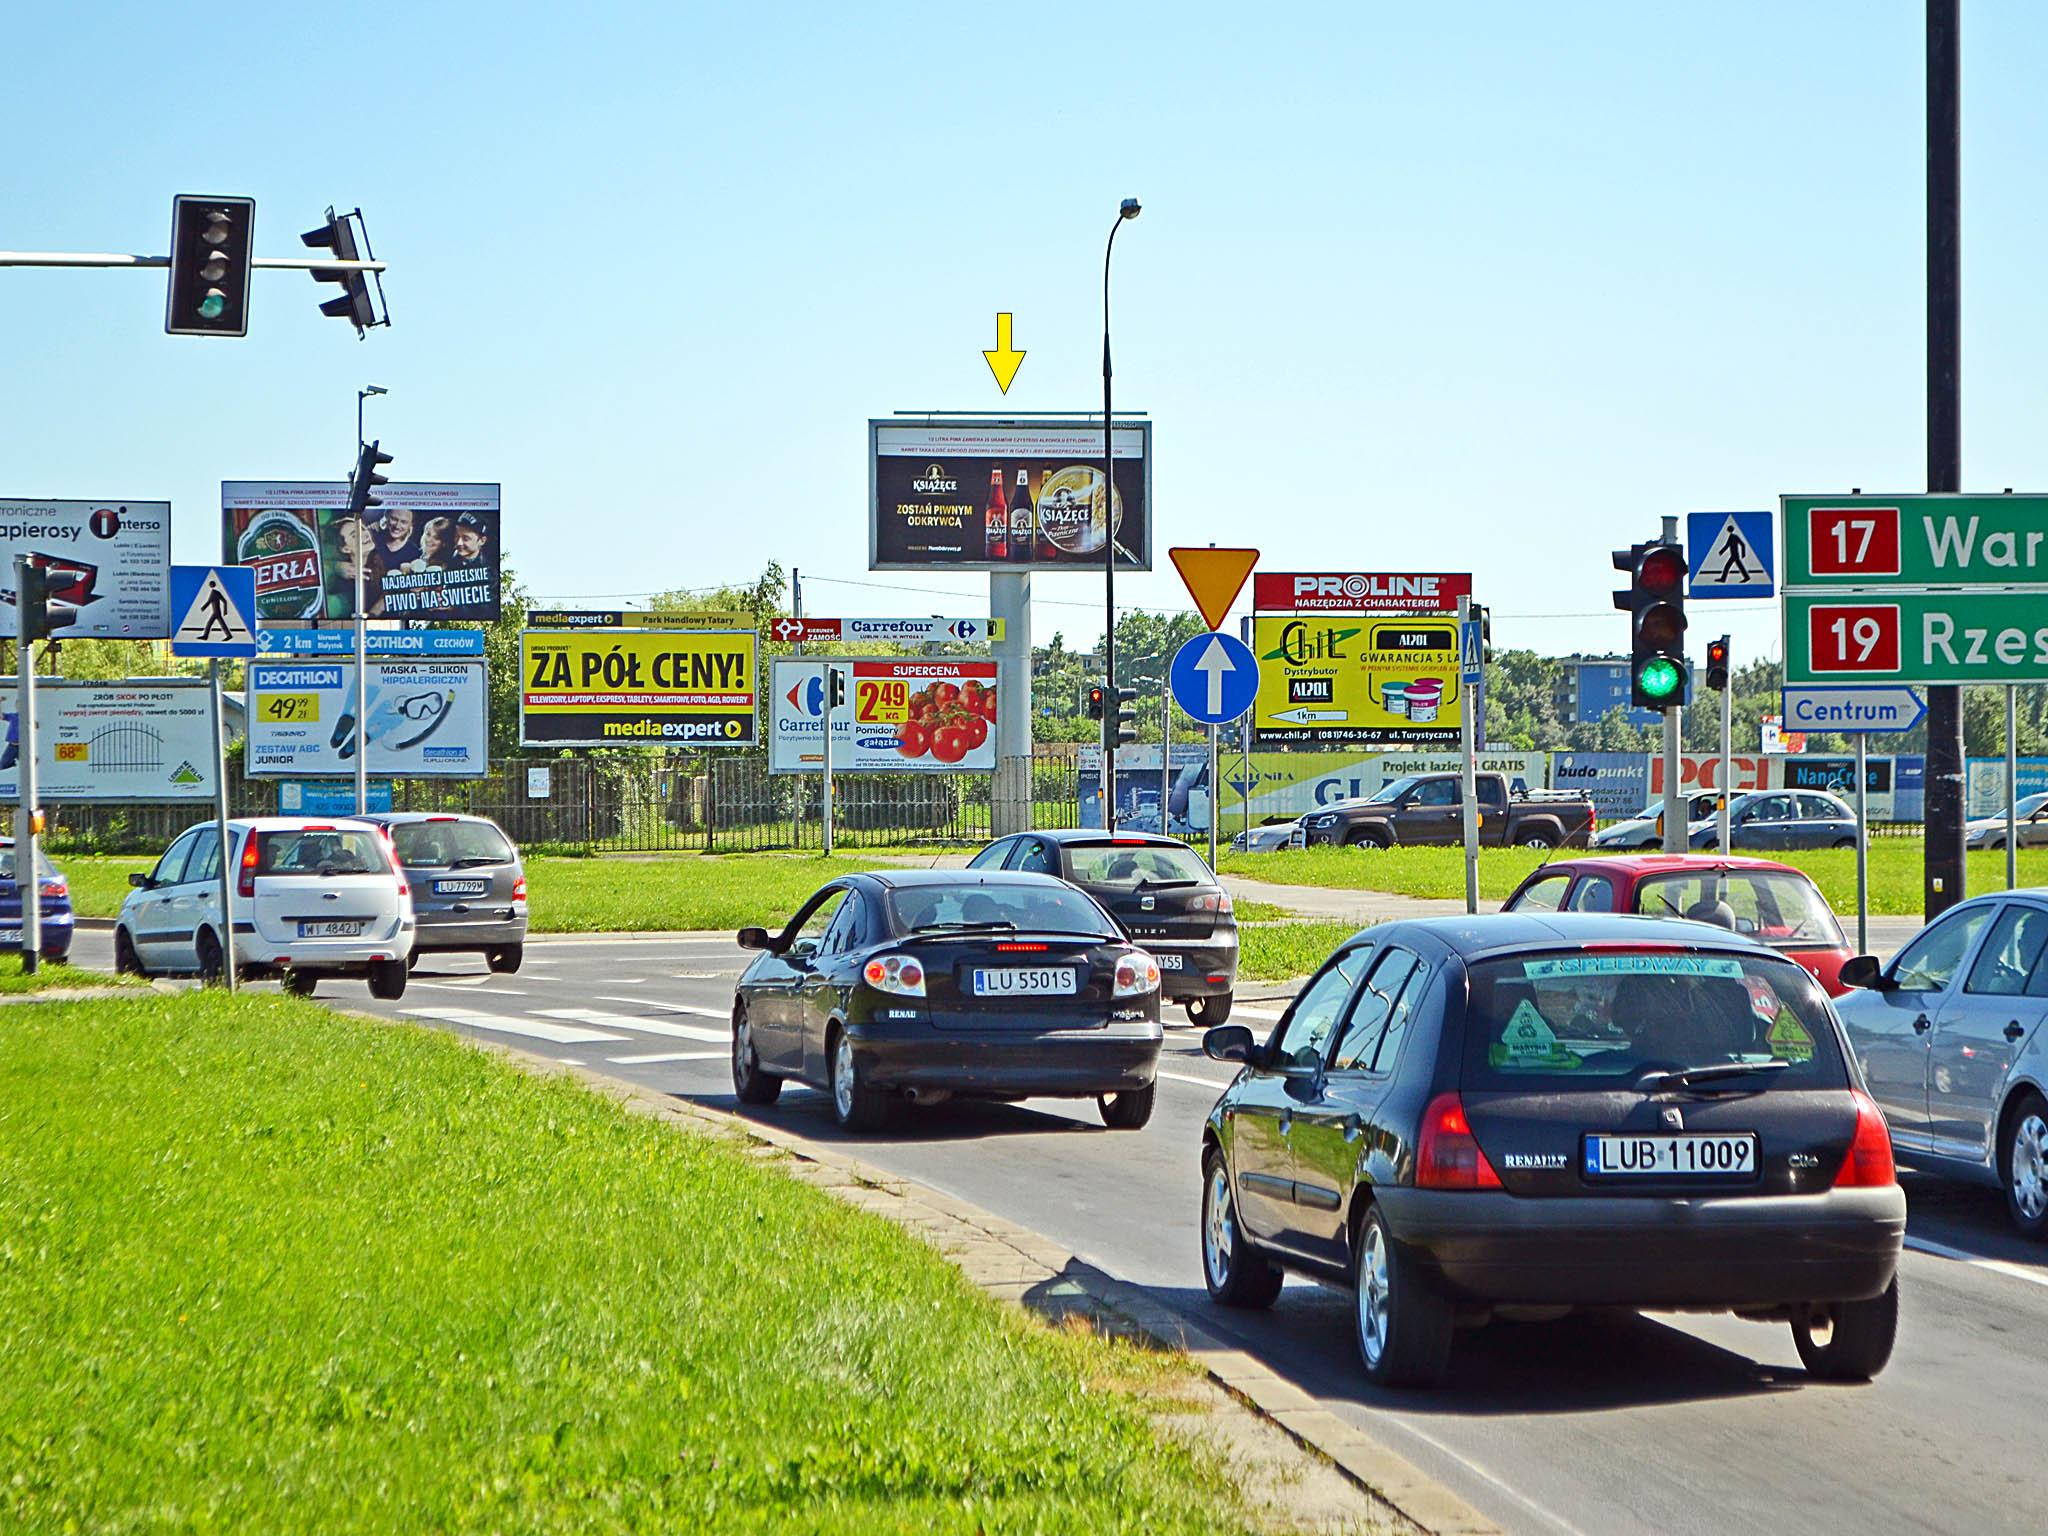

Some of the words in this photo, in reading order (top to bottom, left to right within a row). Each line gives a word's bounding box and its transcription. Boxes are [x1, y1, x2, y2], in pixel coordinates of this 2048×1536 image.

[913, 479, 957, 492] KSIĄŻĘCE
[896, 502, 932, 515] ZOSTAŃ
[934, 505, 973, 516] PIWNYM
[907, 516, 963, 529] ODKRYWCĄ
[1040, 508, 1089, 525] KSIĄŻĘCE
[1831, 519, 1876, 564] 17
[1922, 515, 2045, 568] War
[256, 557, 317, 585] ERŁA
[382, 573, 441, 590] NAJBARDZIEJ
[443, 568, 489, 584] LUBELSKIE
[1294, 575, 1440, 598] PROLINE
[385, 592, 418, 612] PIWO
[421, 590, 439, 609] NA
[441, 584, 491, 606] ŚWIECIE
[1295, 599, 1354, 609] NARZĘDZIA
[1354, 599, 1362, 607] Z
[1363, 599, 1440, 608] CHARAKTEREM
[535, 613, 603, 625] mediaexpert
[642, 616, 662, 625] Park
[663, 616, 706, 626] Handlowy
[707, 616, 734, 626] Tatary
[851, 620, 934, 633] Carrefour
[283, 636, 292, 649] 2
[295, 636, 312, 649] km
[434, 636, 474, 648] CZECHÓW
[807, 632, 841, 641] ZAMOŚĆ
[1831, 617, 1881, 662] 19
[1922, 612, 2048, 665] Rzes
[1360, 652, 1433, 663] GWARANCJA
[1437, 653, 1443, 662] 5
[1447, 652, 1460, 662] LA
[380, 666, 418, 674] MASKA
[428, 666, 468, 674] SILIKON
[530, 652, 573, 688] ZA
[581, 644, 645, 688] PÓŁ
[651, 652, 745, 689] CENY!
[893, 665, 960, 677] SUPERCENA
[1284, 667, 1338, 677] Dystrybutor
[259, 671, 338, 685] DECATHLON
[382, 676, 469, 685] HIPOALERGICZNY
[722, 696, 748, 704] ROWERY
[859, 682, 880, 721] 2
[880, 682, 905, 707] 49
[268, 697, 296, 719] 49
[1795, 699, 1898, 721] Centrum
[885, 711, 899, 720] KG
[1296, 711, 1317, 720] 1km
[603, 719, 722, 740] mediaexpert
[779, 718, 851, 732] Carrefur
[855, 726, 899, 735] Pomidory
[1318, 730, 1382, 741] (081)746-36-67
[1389, 731, 1400, 740] ul.
[1401, 730, 1454, 741] Turystyczna
[255, 744, 296, 753] ZESTAW
[298, 744, 320, 753] ABC
[863, 738, 899, 748] gałązka
[59, 746, 76, 759] 68
[255, 755, 294, 764] JUNIOR
[168, 766, 185, 783] LEROY
[183, 760, 205, 782] MERLIN
[1382, 760, 1425, 773] Projekt
[1429, 760, 1478, 773] łaziei
[1482, 760, 1526, 772] GRATIS
[1557, 765, 1644, 780] budopunkt
[1651, 757, 1768, 794] PCI
[1797, 767, 1878, 786] NanoCre
[440, 881, 454, 892] LU
[305, 924, 319, 936] WI
[325, 922, 358, 935] 4842J
[1561, 957, 1708, 972] SPEEDWAY
[987, 972, 1012, 991] LU
[1019, 970, 1072, 990] 5501S
[888, 1010, 917, 1018] RENAU
[1504, 1154, 1568, 1168] RENAULT
[1602, 1141, 1656, 1170] LUB
[1668, 1140, 1749, 1170] 11009
[1788, 1154, 1819, 1168] Clio
